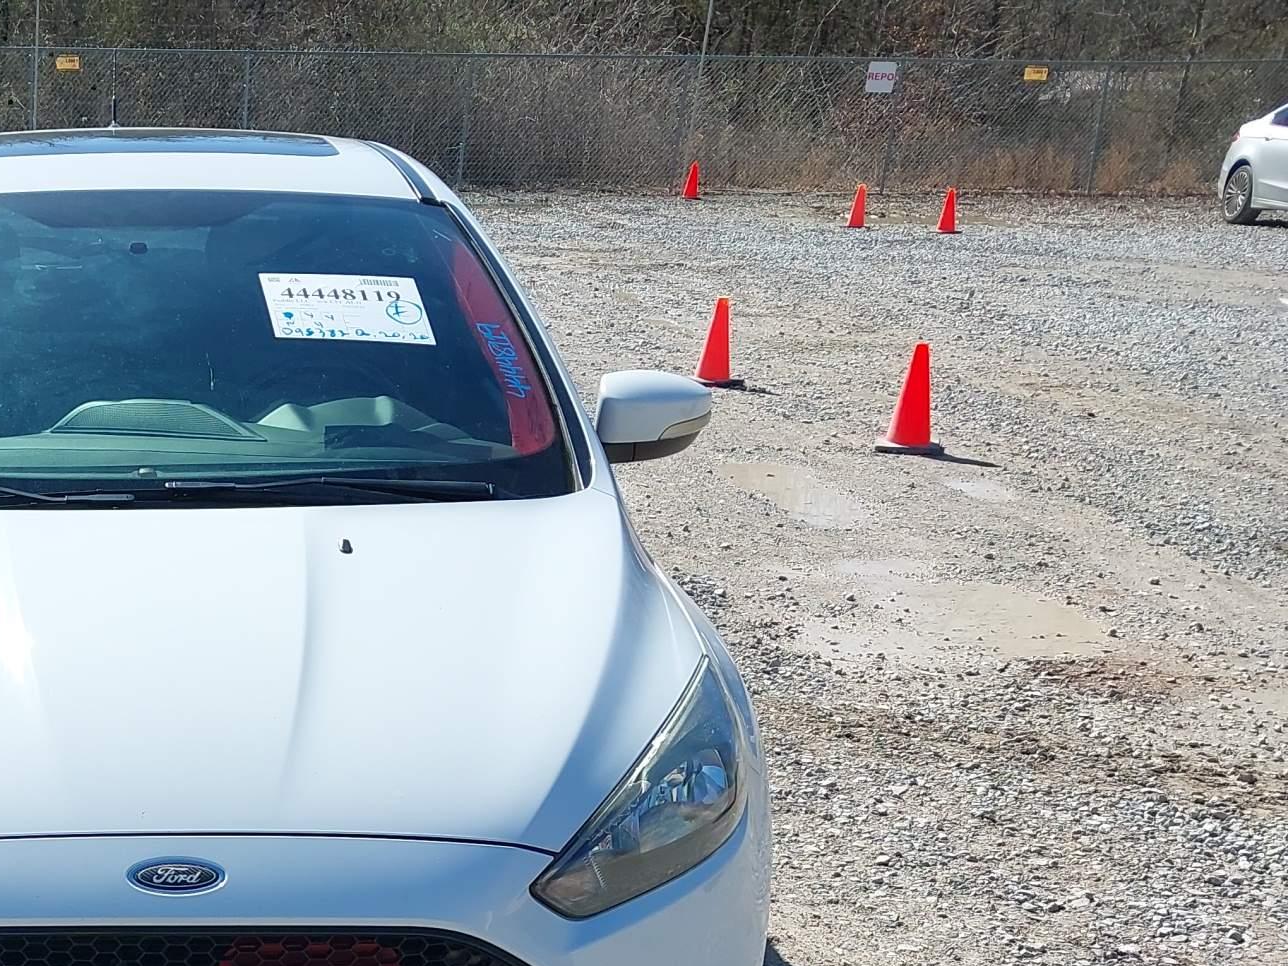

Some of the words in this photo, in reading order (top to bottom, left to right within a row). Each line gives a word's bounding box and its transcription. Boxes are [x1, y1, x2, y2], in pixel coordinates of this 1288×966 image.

[867, 72, 894, 81] REPO
[280, 286, 401, 302] 44448119
[153, 866, 201, 884] Ford
